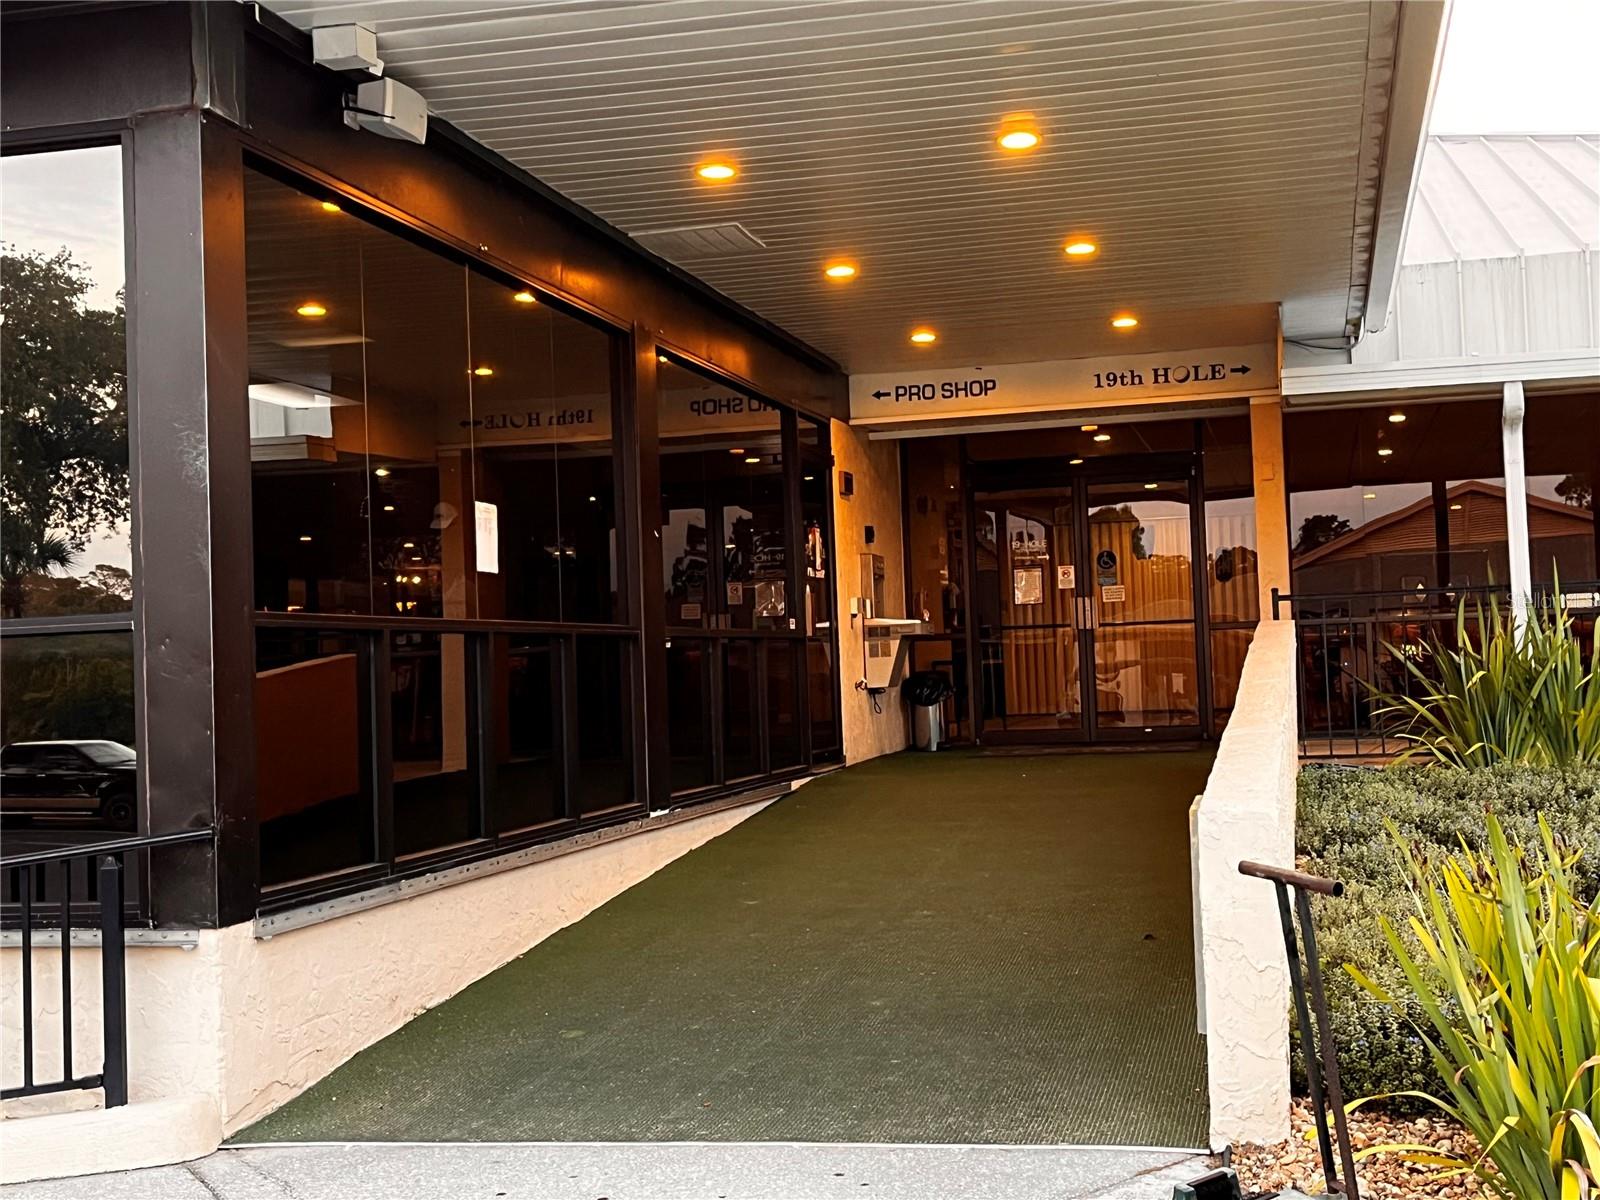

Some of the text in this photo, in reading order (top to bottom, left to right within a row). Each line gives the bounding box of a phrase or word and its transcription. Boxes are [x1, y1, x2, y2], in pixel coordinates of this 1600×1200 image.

[1093, 363, 1226, 388] 19th HOLE
[895, 379, 997, 402] PRO SHOP
